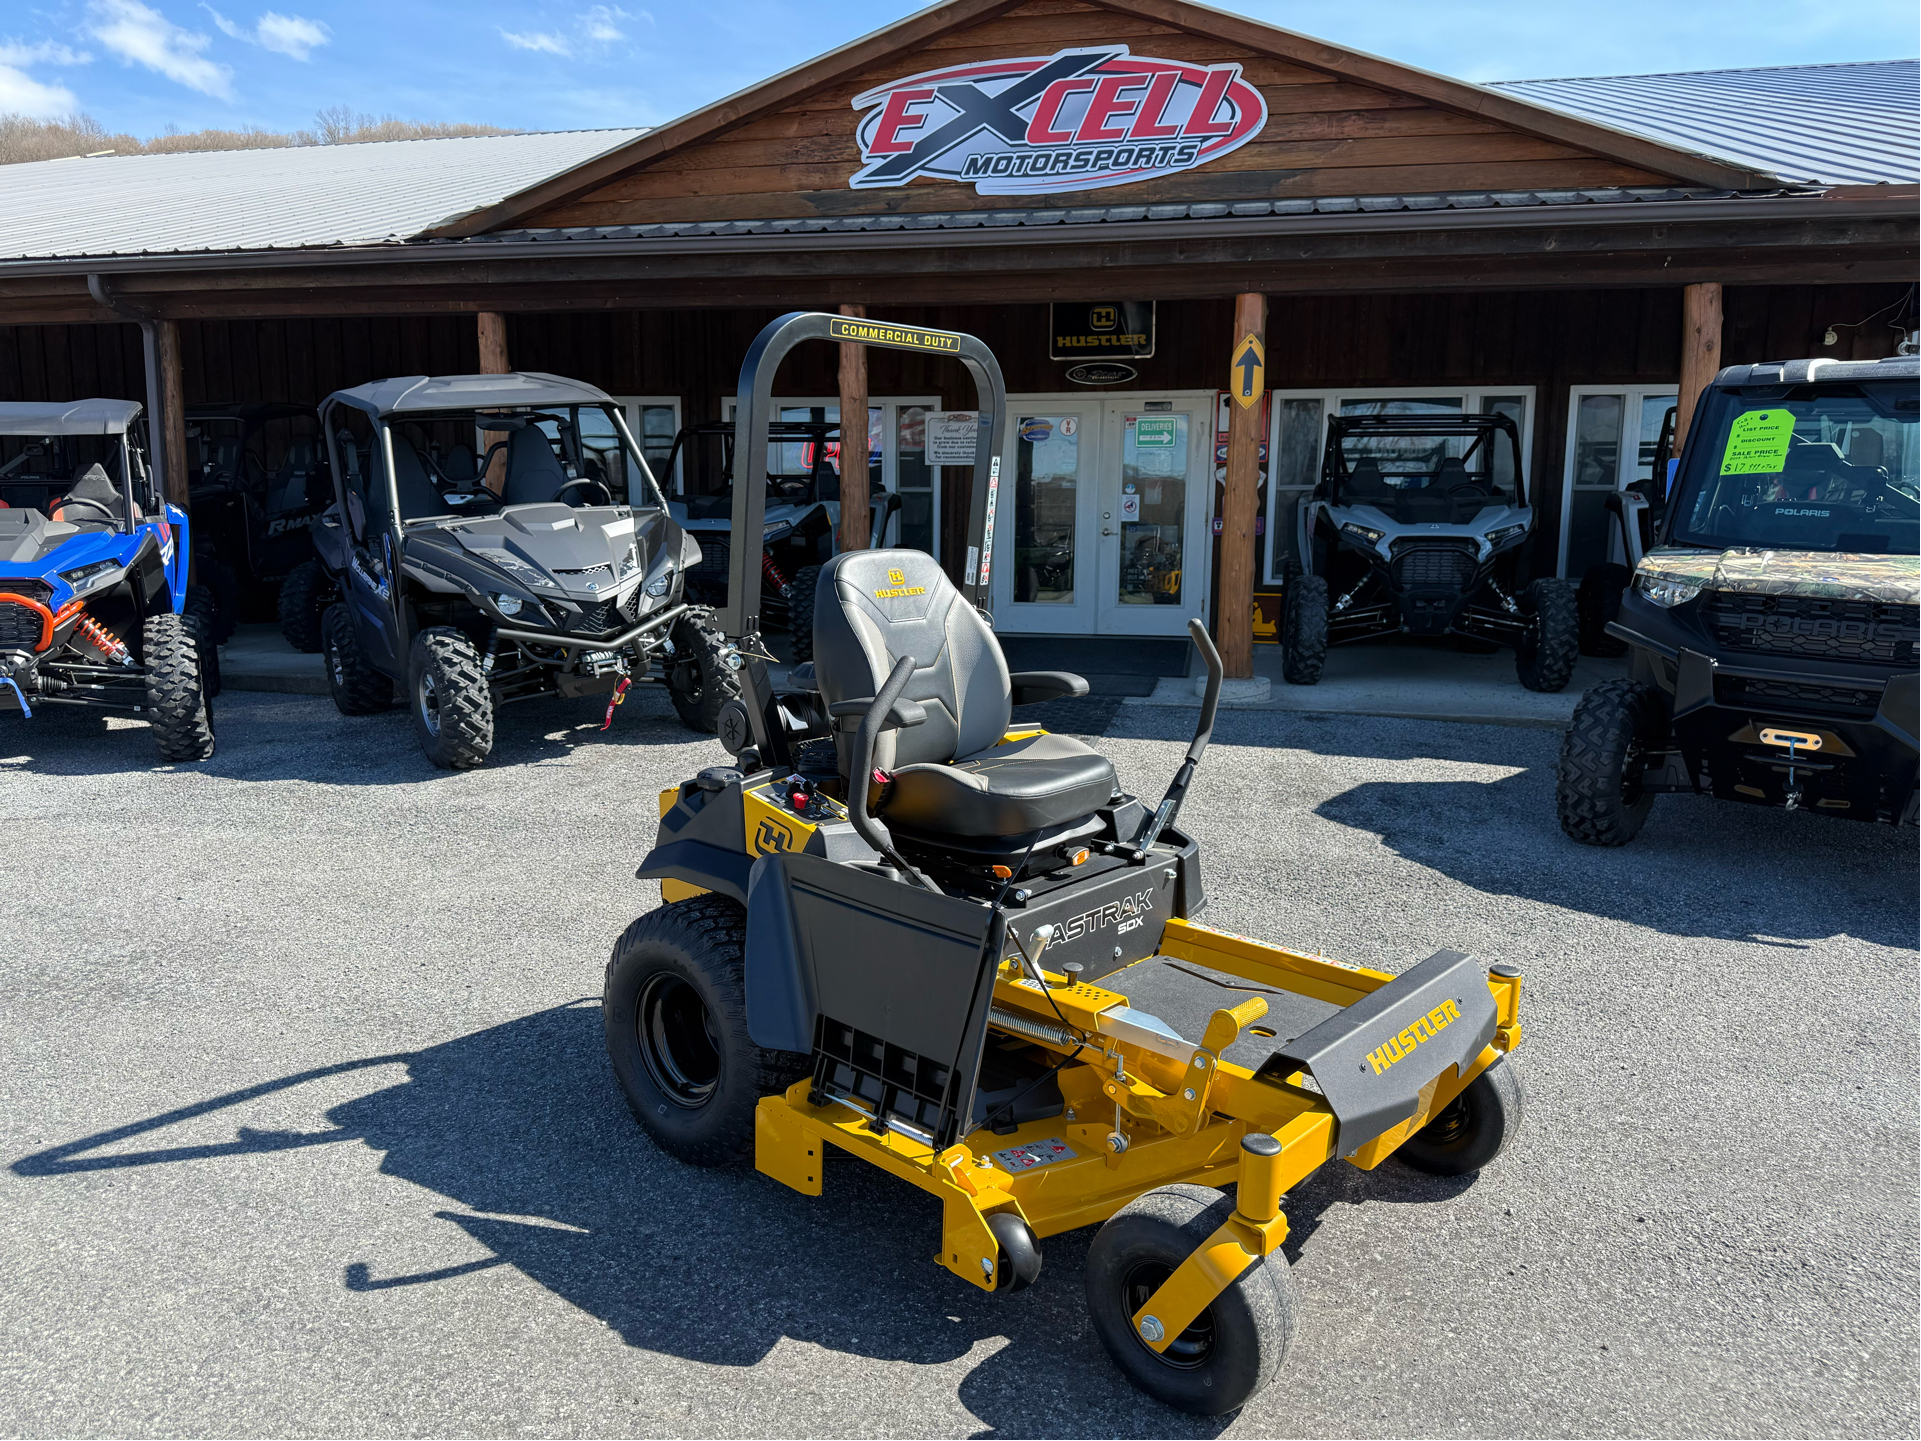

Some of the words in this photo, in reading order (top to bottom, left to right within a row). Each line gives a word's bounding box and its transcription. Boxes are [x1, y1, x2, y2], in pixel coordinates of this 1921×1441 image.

[863, 53, 1238, 179] EXCELL
[963, 144, 1198, 177] MOTORSPORTS
[841, 324, 919, 344] COMMERCIAL
[924, 335, 953, 348] DUTY
[1056, 333, 1147, 347] HUSTLER
[1141, 423, 1172, 431] DELIVERIES
[1775, 508, 1830, 517] POLARIS
[873, 586, 927, 599] HUSTLER
[1739, 613, 1905, 642] POLARIS
[1117, 916, 1144, 934] SDX
[1365, 998, 1462, 1076] HUSTLER
